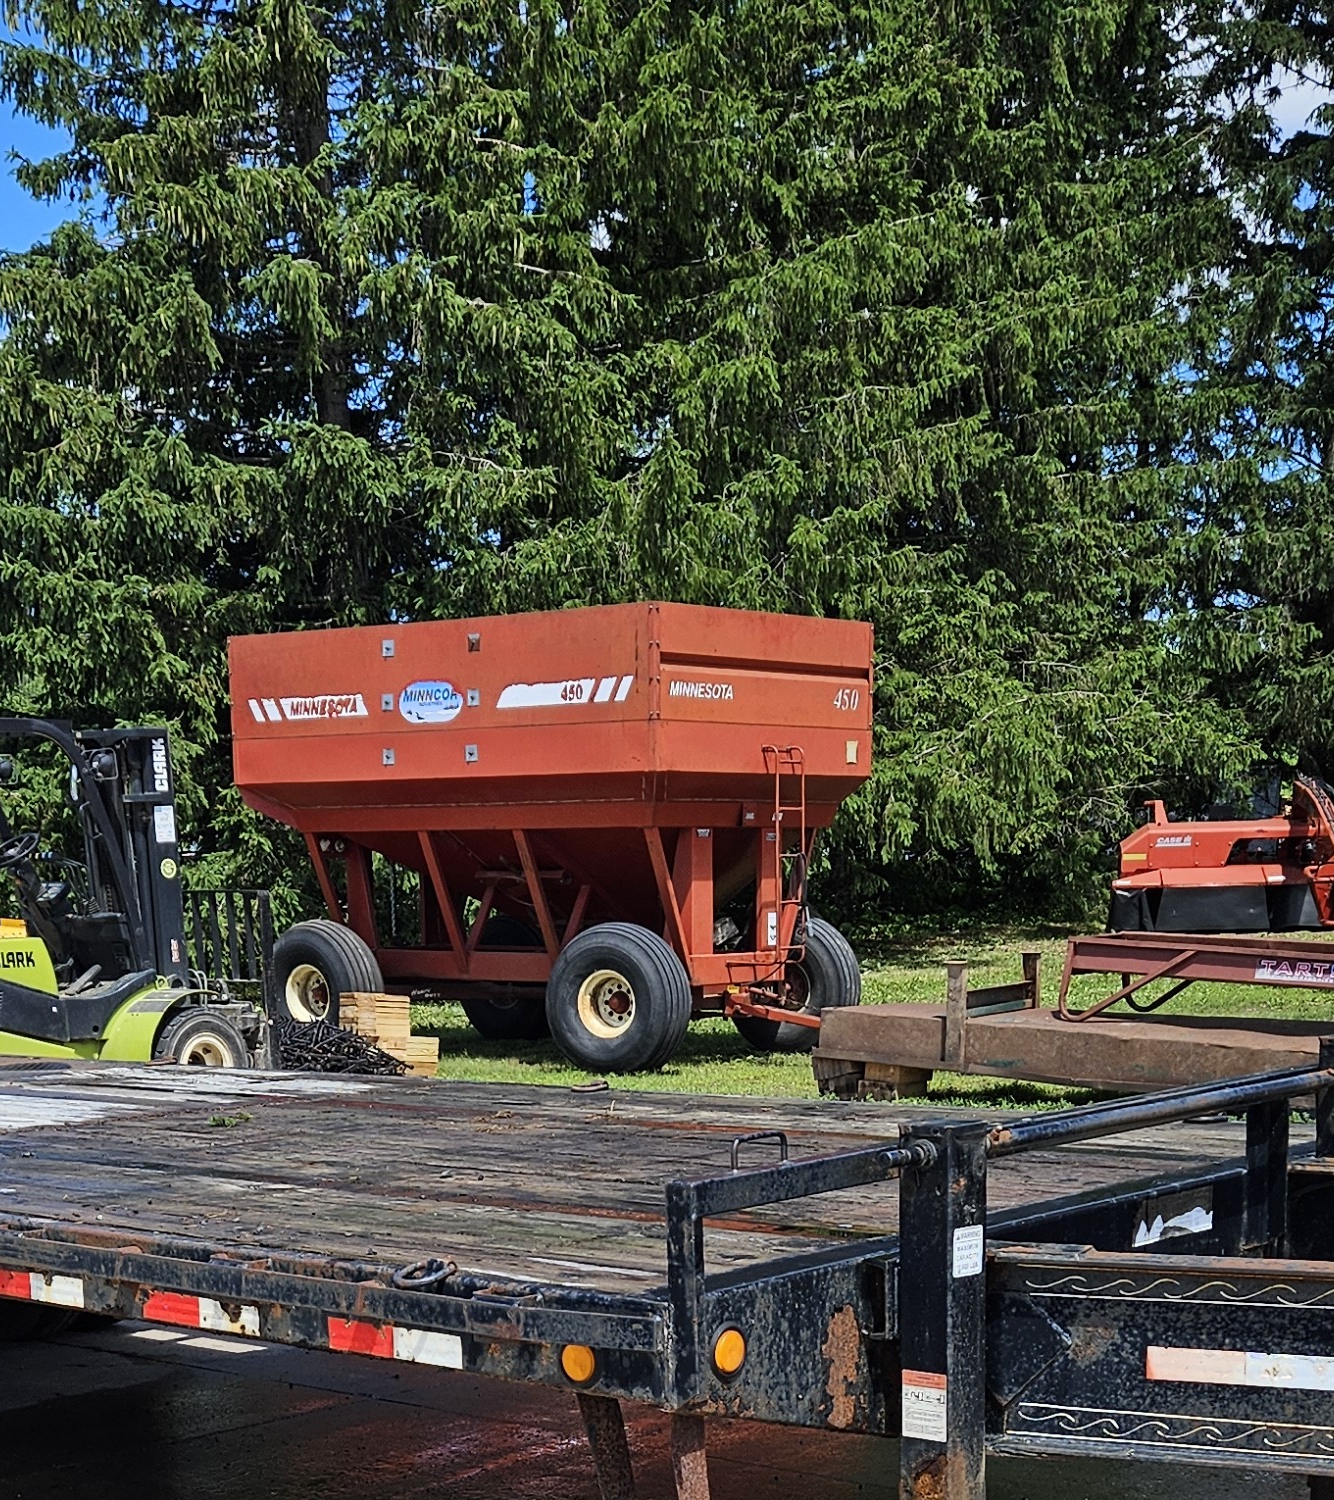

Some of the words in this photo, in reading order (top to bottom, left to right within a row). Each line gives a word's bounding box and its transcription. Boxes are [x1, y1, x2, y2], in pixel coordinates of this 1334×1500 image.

[669, 680, 734, 700] MINNESOTA
[833, 688, 860, 711] 450
[152, 738, 169, 792] CLARK
